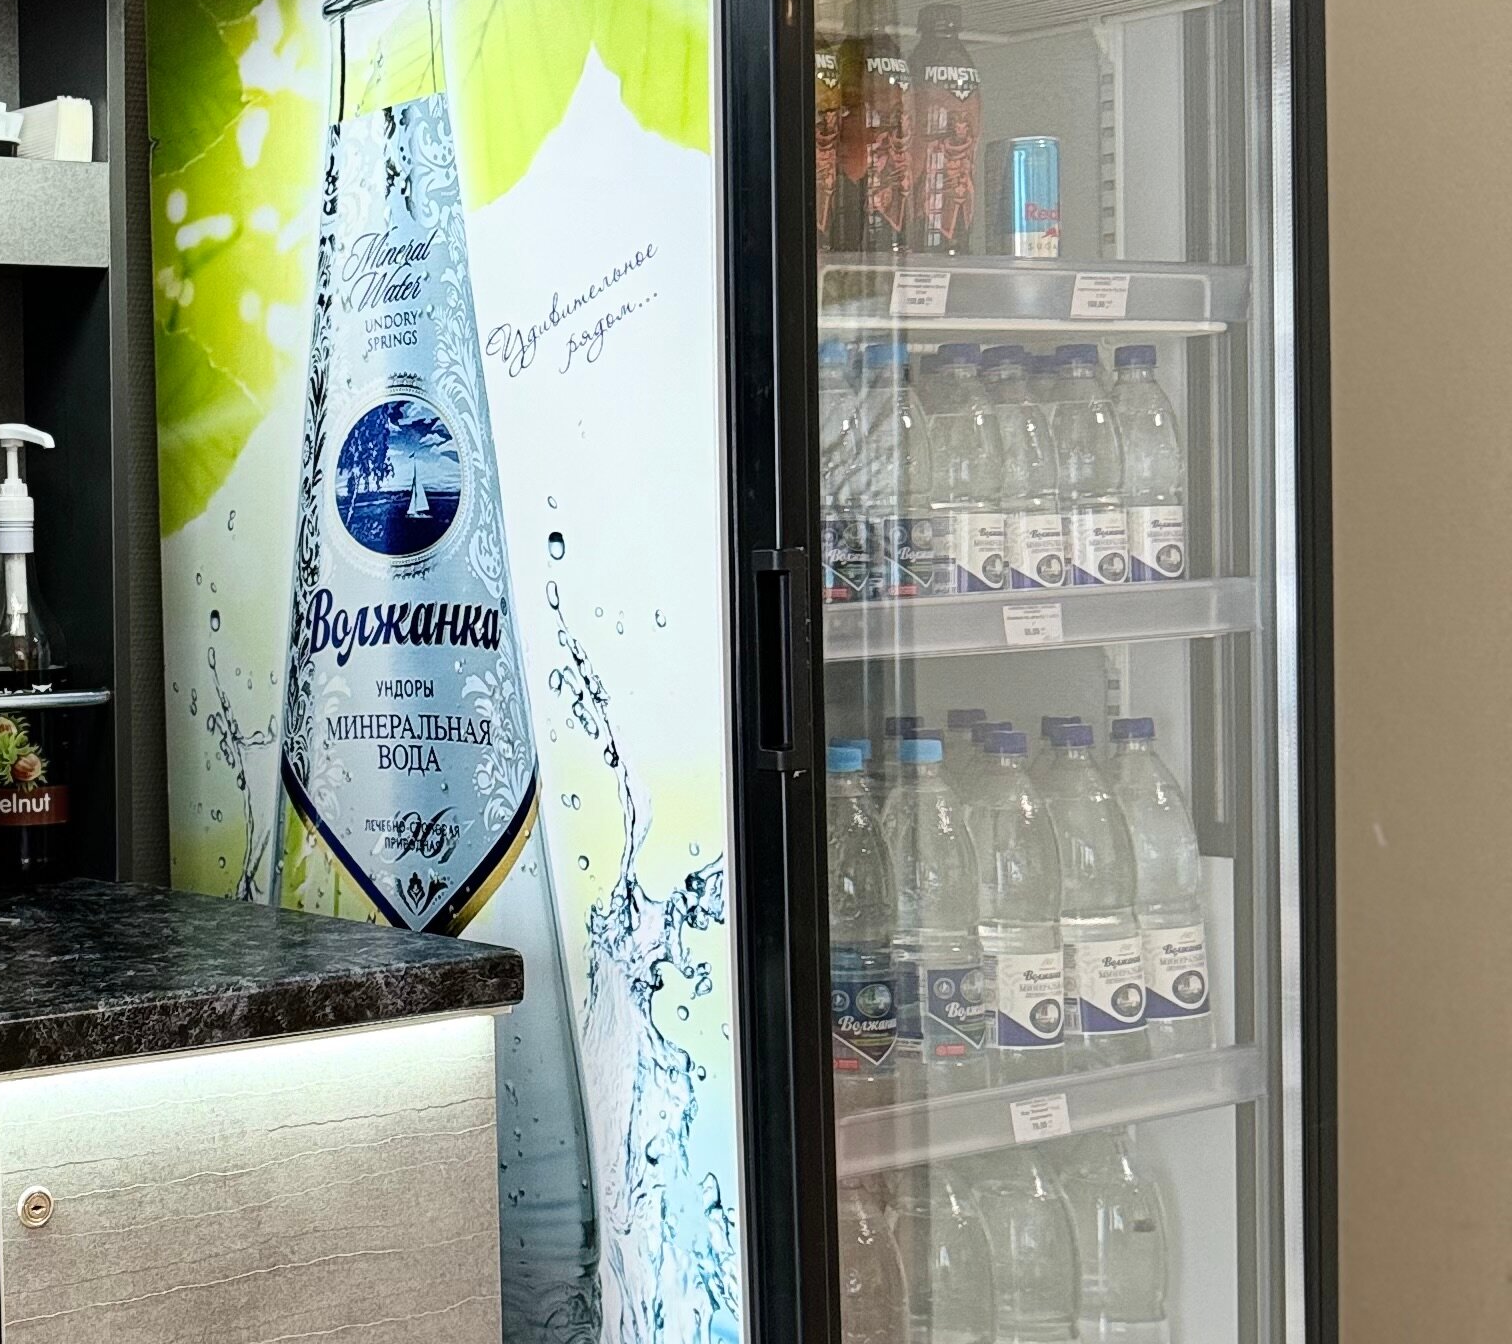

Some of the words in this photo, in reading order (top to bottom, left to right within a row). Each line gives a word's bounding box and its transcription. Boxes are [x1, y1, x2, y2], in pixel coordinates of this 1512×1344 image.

[342, 226, 439, 283] Mineral
[349, 262, 423, 313] Water
[365, 310, 419, 334] UNDORY
[485, 243, 659, 378] Удивительное
[367, 330, 418, 353] SPRINGS
[306, 588, 502, 667] Волжанка
[376, 679, 434, 699] УНДОРЫ
[325, 713, 493, 747] МИНЕРАЛЬНАЯ
[377, 743, 442, 776] ВОДА
